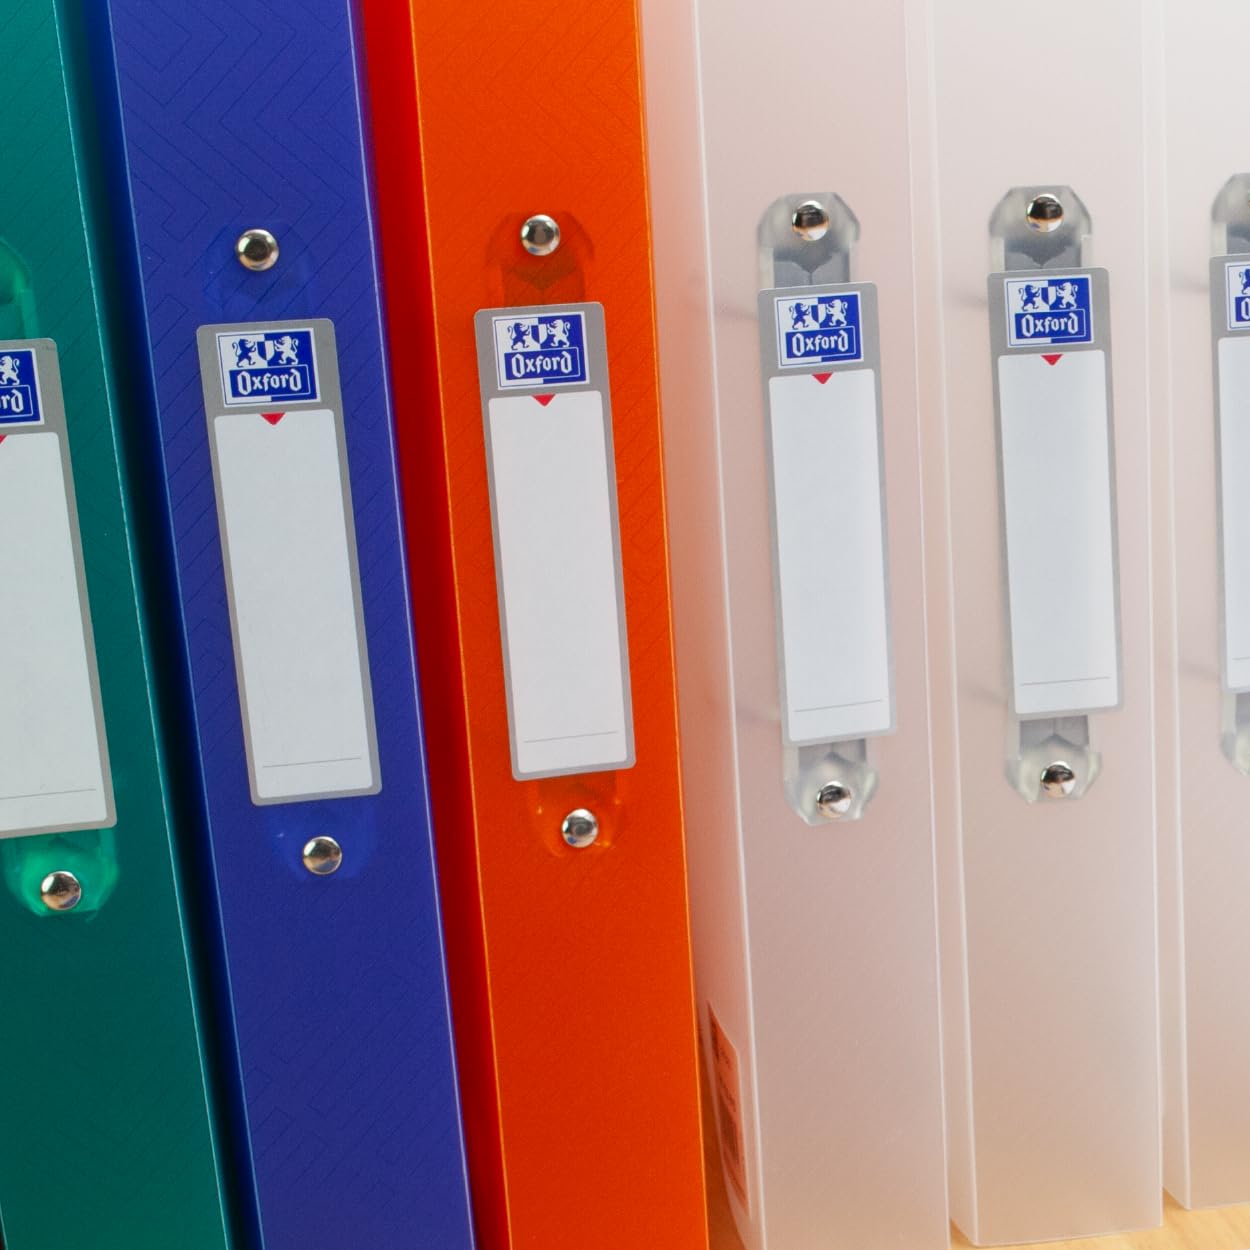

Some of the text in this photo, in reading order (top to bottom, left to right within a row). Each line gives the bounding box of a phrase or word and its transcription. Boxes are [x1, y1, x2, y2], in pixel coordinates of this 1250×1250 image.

[1021, 313, 1078, 338] Oxford
[792, 333, 849, 357] Oxford
[512, 352, 572, 378] Oxford
[238, 368, 302, 394] Oxford
